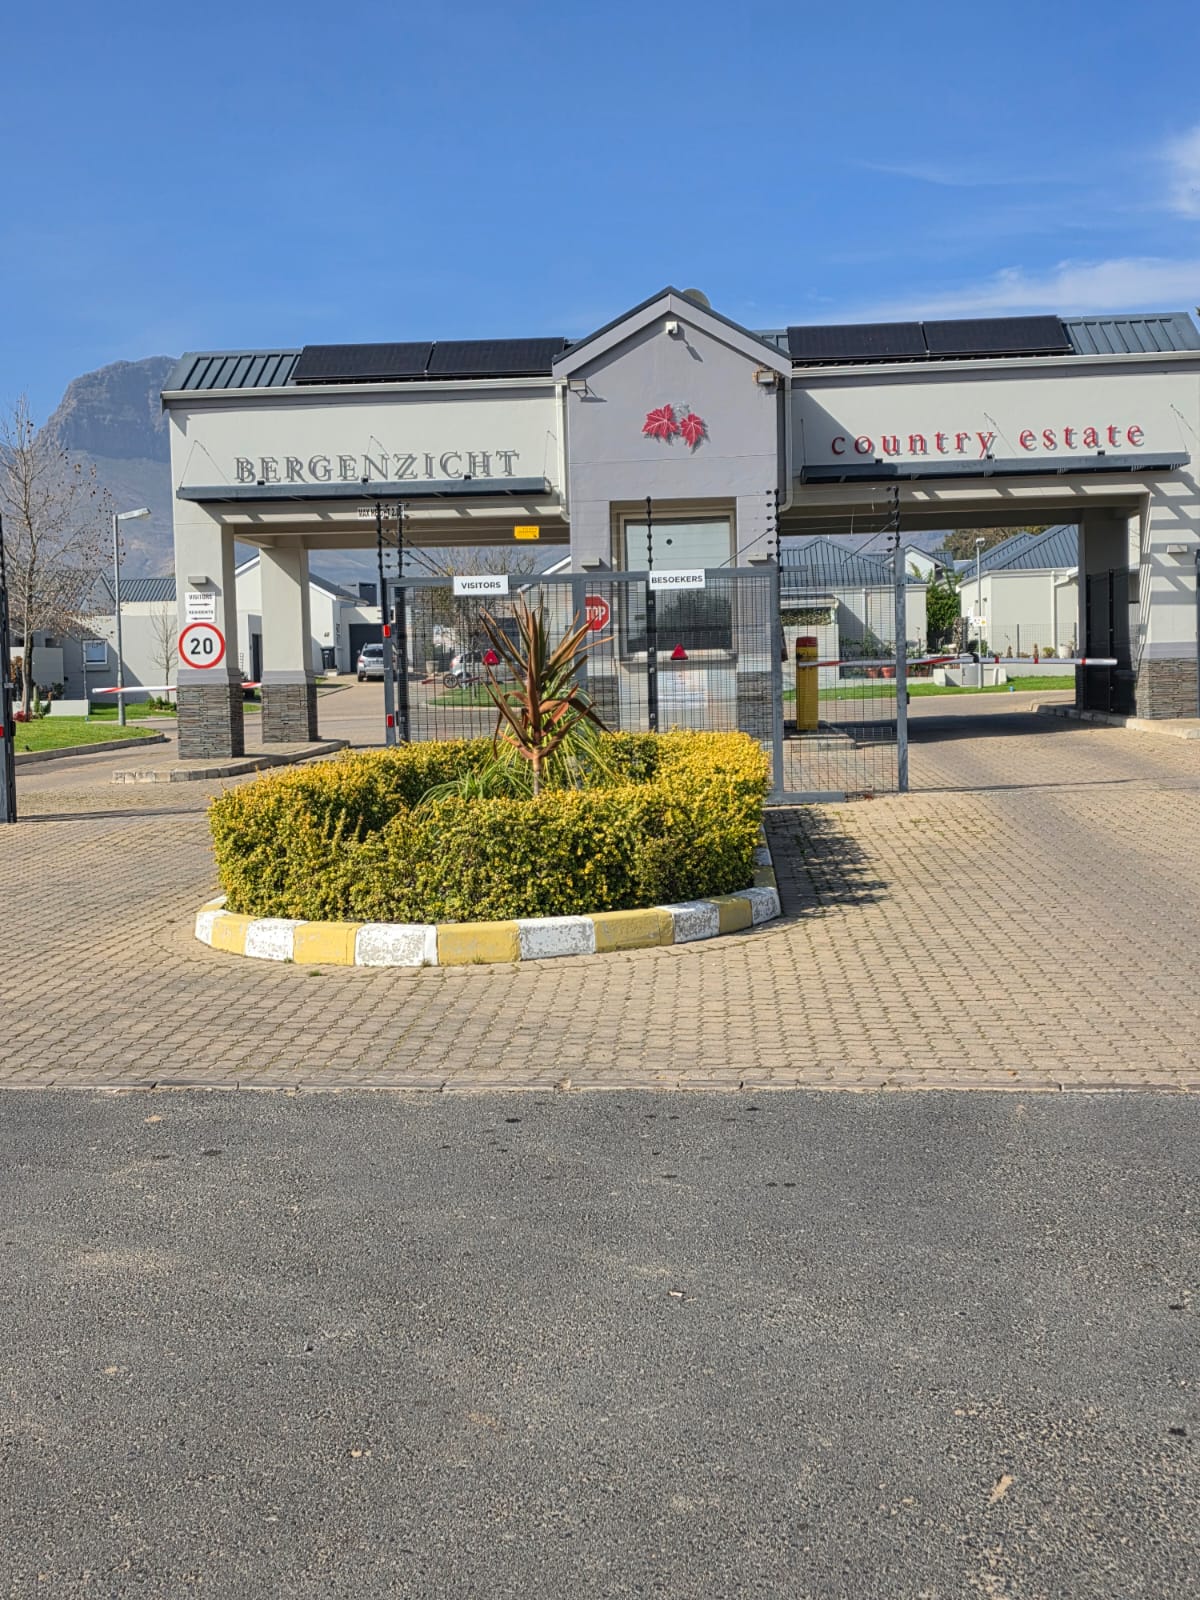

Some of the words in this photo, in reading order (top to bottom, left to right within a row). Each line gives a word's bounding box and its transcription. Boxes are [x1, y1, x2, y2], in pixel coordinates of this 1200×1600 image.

[831, 430, 995, 458] country
[1019, 424, 1143, 448] estate
[234, 450, 519, 483] BERGENZICHT
[651, 575, 703, 583] BESOEKERS
[585, 605, 606, 621] TOP
[190, 638, 213, 655] 20
